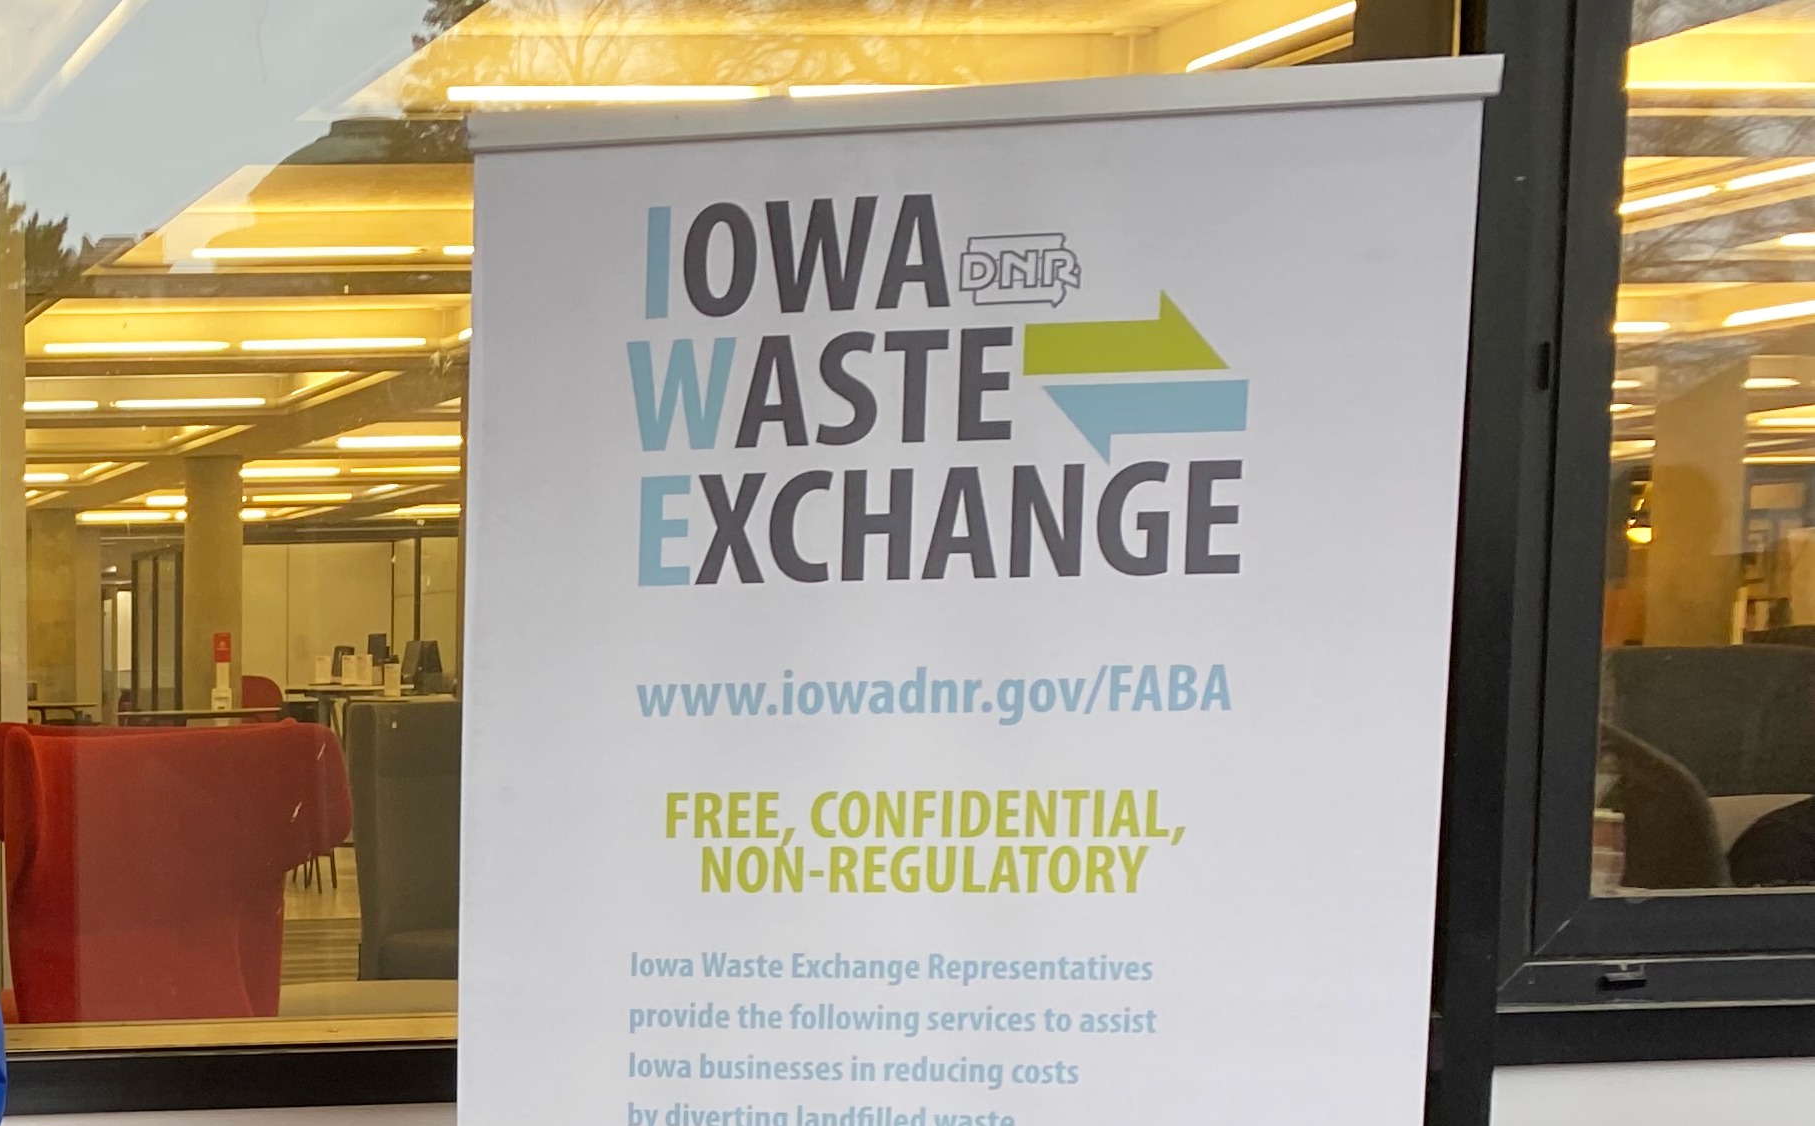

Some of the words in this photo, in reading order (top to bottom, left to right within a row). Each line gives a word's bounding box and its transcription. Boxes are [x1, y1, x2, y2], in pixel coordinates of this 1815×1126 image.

[645, 193, 950, 319] IOWA
[959, 247, 1081, 292] DNR
[626, 326, 1013, 453] WASTE
[637, 459, 1243, 588] EXCHANGE
[637, 664, 1232, 726] www.iowadnr.gov/FABA
[665, 791, 795, 846] FREE,
[810, 789, 1186, 846] CONFIDENTIAL,
[701, 845, 1149, 893] NON-REGULATORY
[631, 952, 694, 978] Iowa
[702, 952, 784, 978] Waste
[791, 953, 920, 986] Exchange
[928, 953, 1153, 986] Representatives
[629, 1002, 730, 1033] provide
[738, 1003, 783, 1029] the
[789, 1003, 920, 1037] following
[927, 1005, 1036, 1031] services
[1043, 1008, 1072, 1032] to
[1079, 1007, 1157, 1033] assist
[628, 1052, 691, 1078] Iowa
[700, 1053, 843, 1080] businesses
[850, 1055, 875, 1081] in
[883, 1056, 1003, 1090] reducing
[1012, 1061, 1079, 1084] costs
